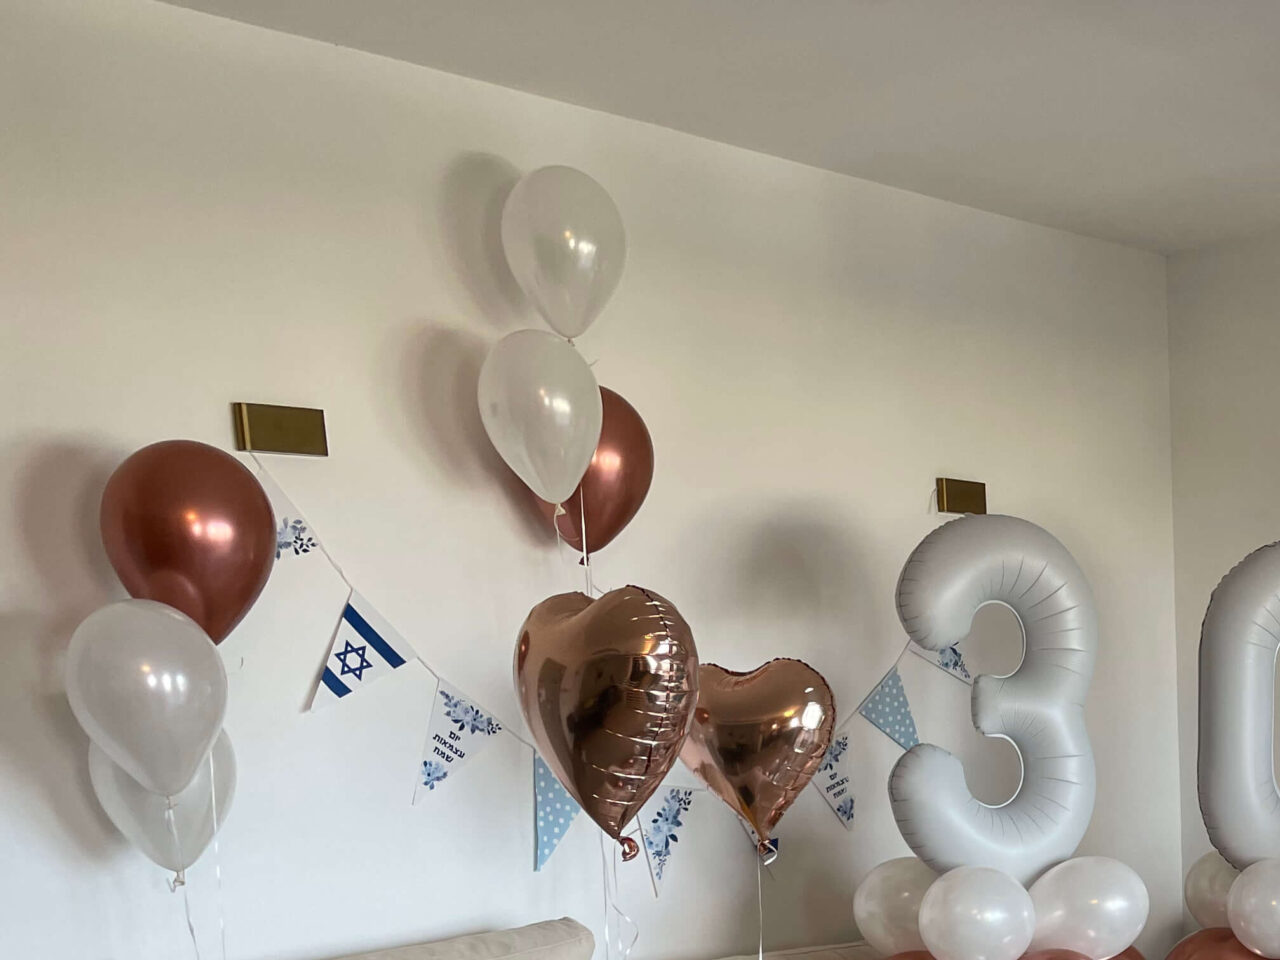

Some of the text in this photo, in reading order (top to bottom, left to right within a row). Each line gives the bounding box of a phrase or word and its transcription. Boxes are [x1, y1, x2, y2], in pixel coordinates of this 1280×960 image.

[448, 731, 461, 742] יום
[432, 733, 466, 759] עצמאות
[433, 746, 454, 763] שמח
